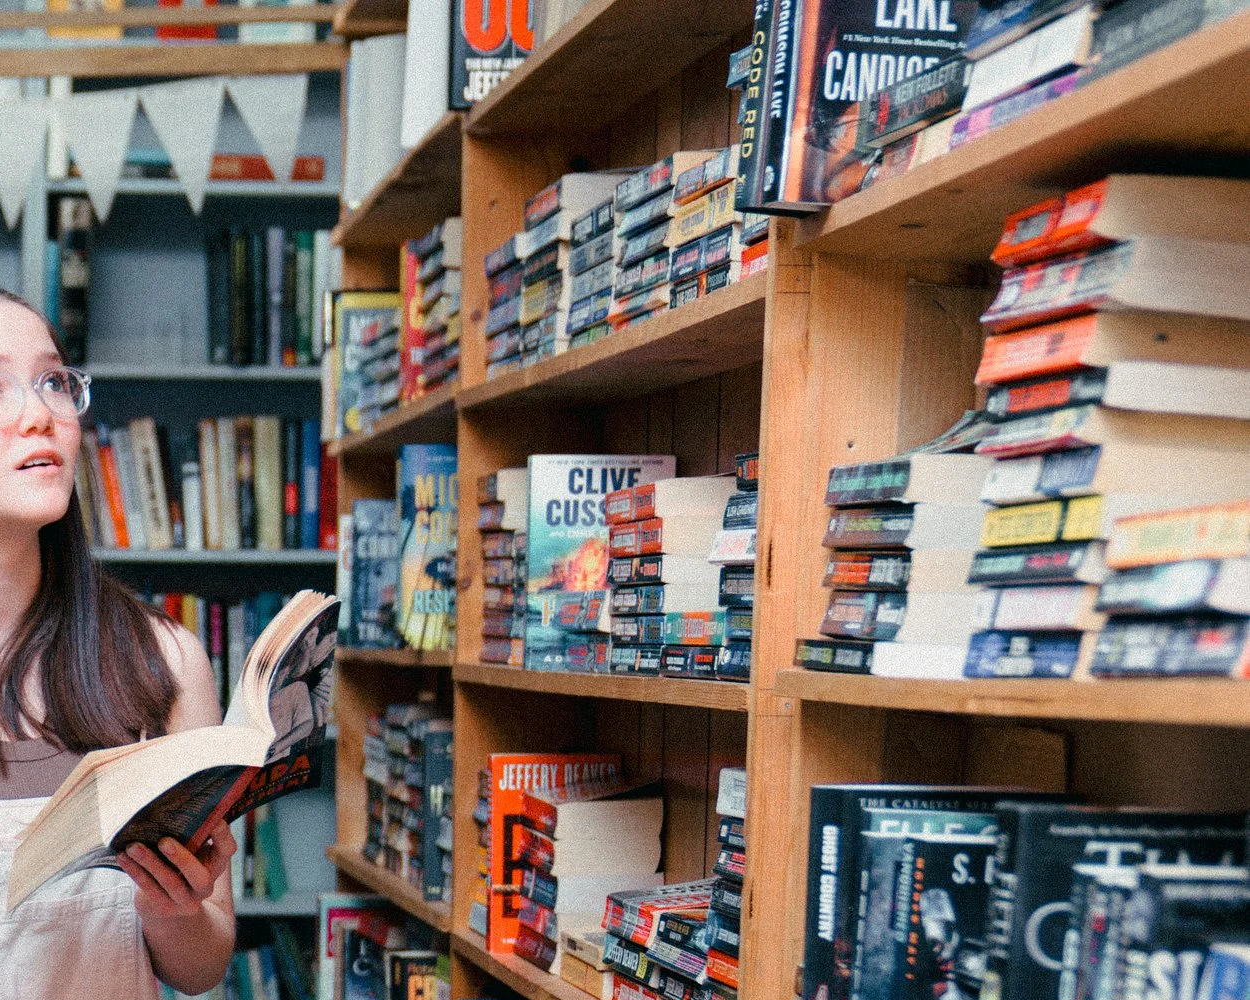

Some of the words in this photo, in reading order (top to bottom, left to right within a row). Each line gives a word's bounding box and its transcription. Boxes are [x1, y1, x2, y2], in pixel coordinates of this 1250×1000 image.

[874, 0, 958, 32] LAKE
[855, 34, 871, 43] New
[872, 35, 889, 45] York
[891, 36, 913, 46] Times
[747, 30, 765, 100] CODE
[769, 79, 784, 119] LAKE
[741, 109, 757, 159] RED
[567, 467, 642, 496] CLIVE
[499, 763, 559, 792] JEFFERY
[564, 762, 617, 785] DEAVER
[858, 797, 886, 809] THE
[892, 798, 960, 810] CATALYST
[821, 824, 839, 874] GHOST
[818, 874, 837, 942] COUNTRY
